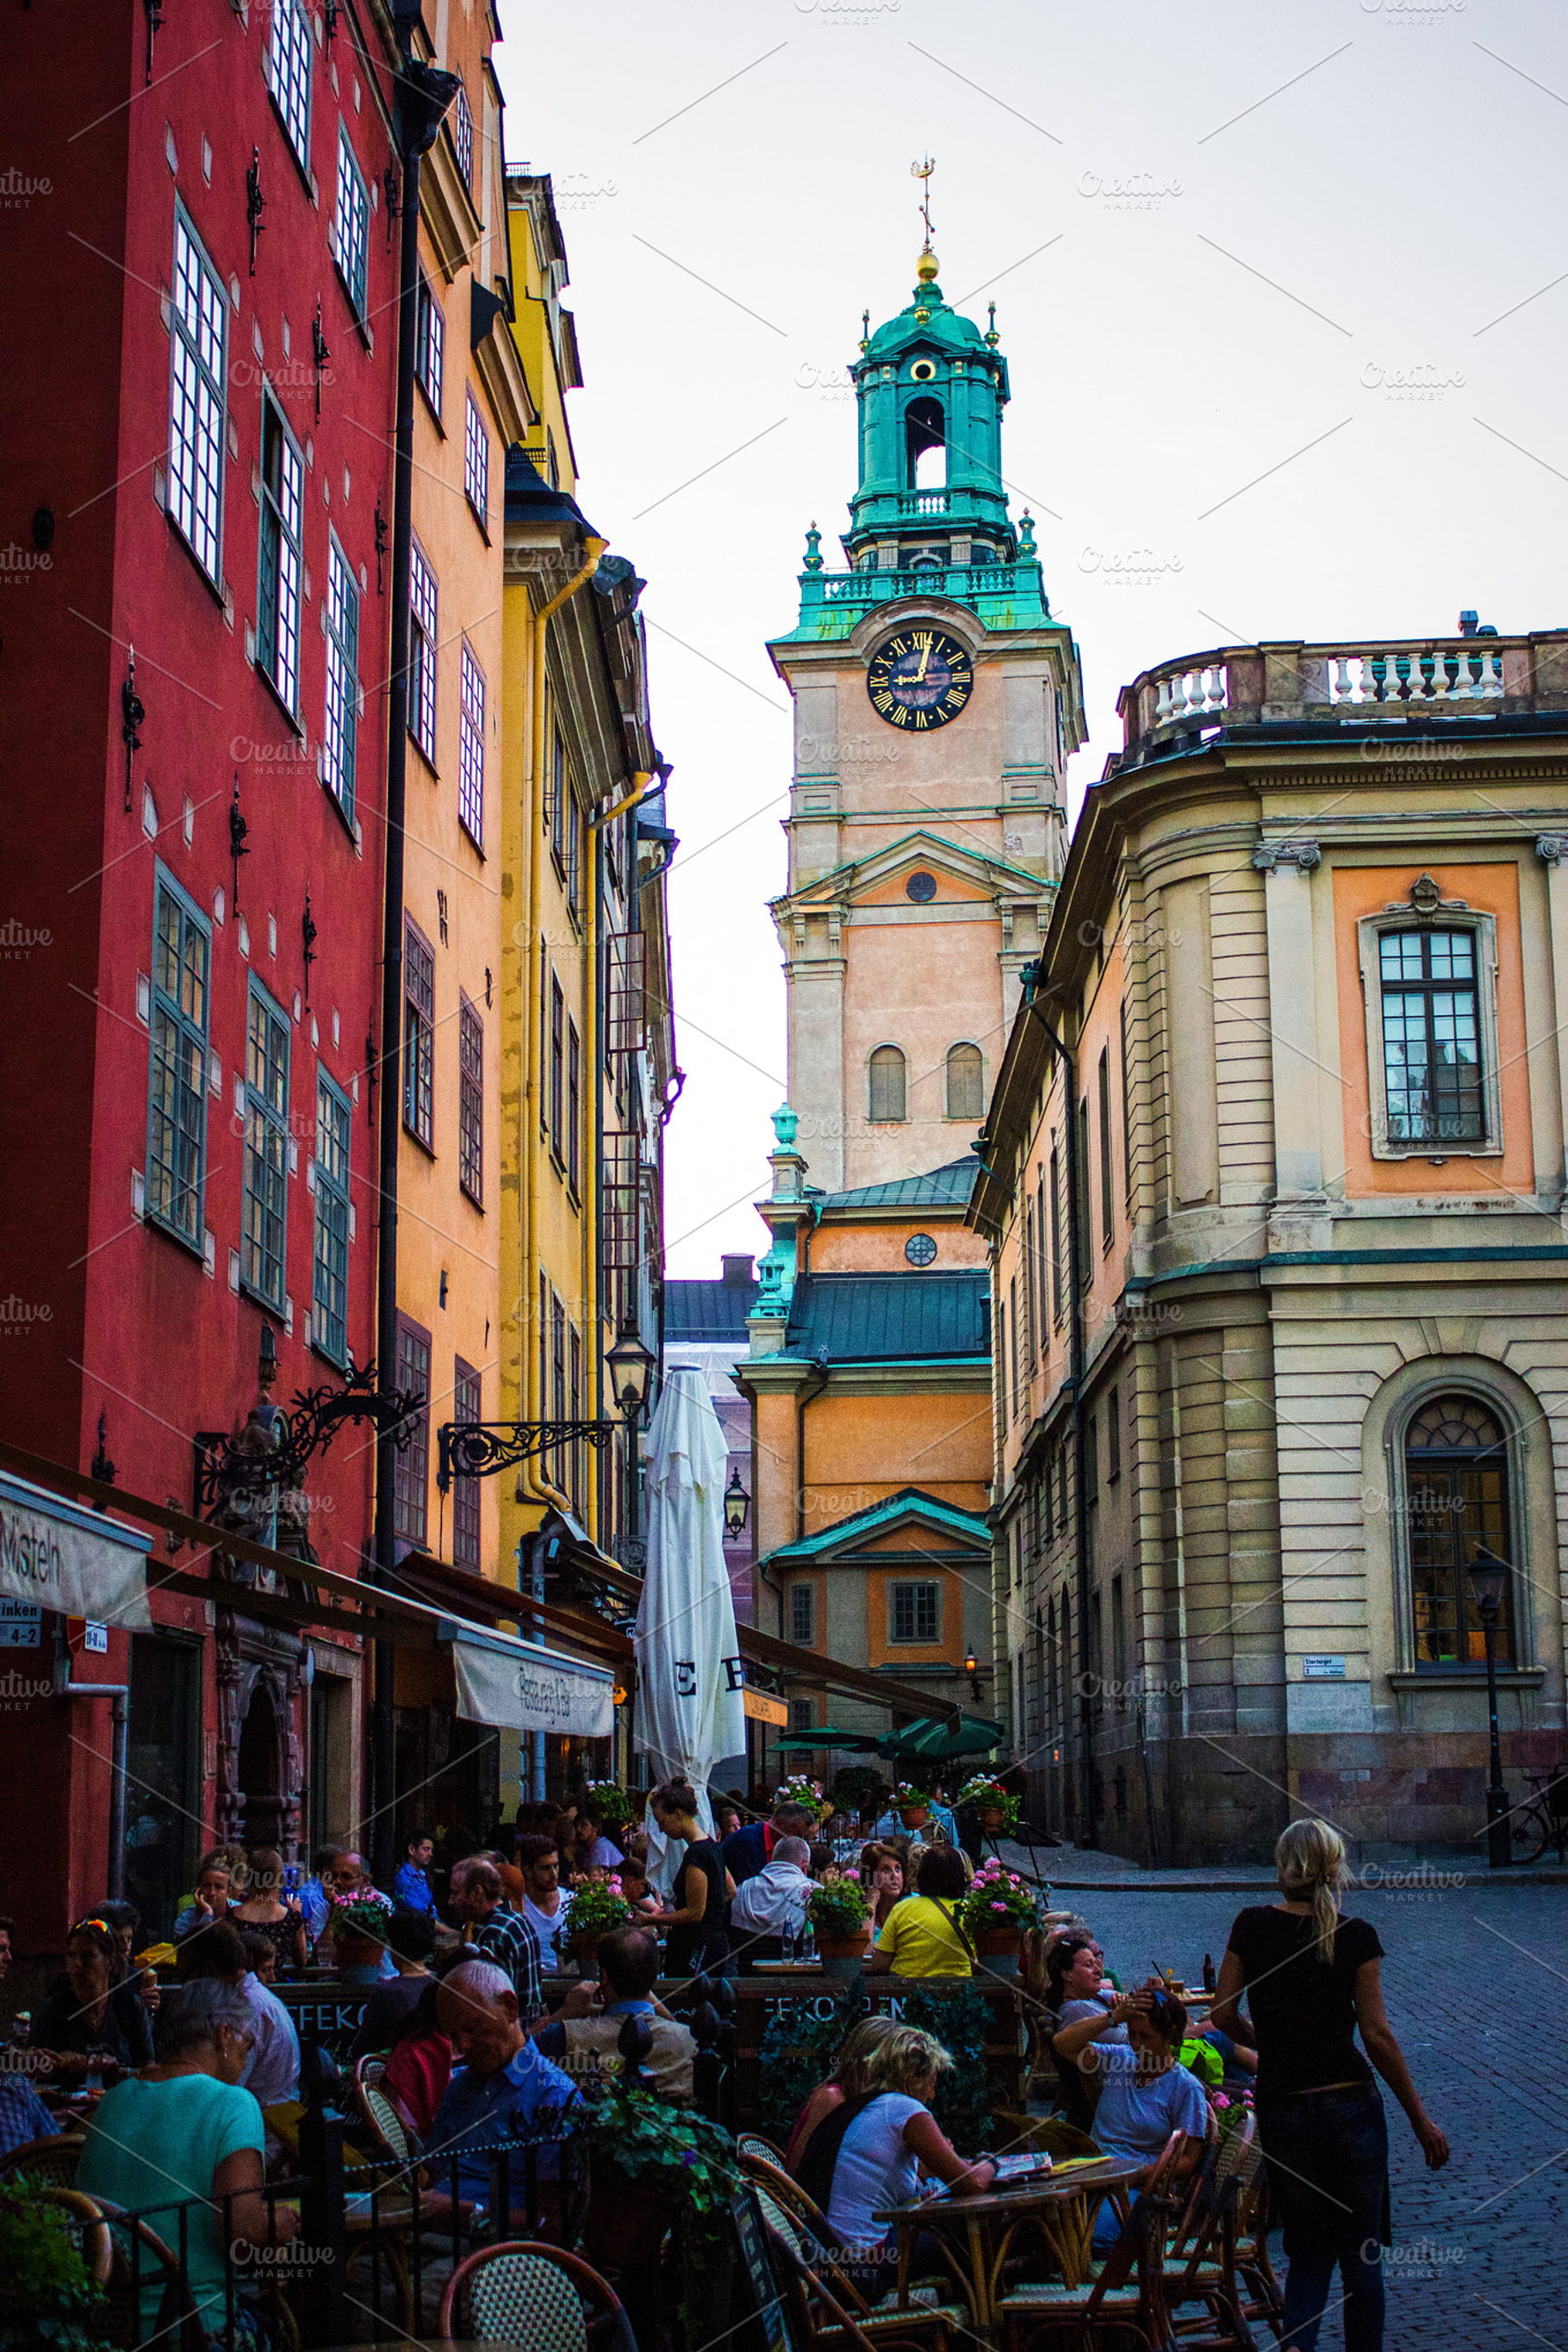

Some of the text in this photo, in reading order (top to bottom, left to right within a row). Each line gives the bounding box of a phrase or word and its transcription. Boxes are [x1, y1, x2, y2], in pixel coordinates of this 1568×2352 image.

[890, 638, 907, 657] XI
[875, 656, 894, 669] X
[870, 676, 889, 688] IX
[916, 711, 928, 728] VI
